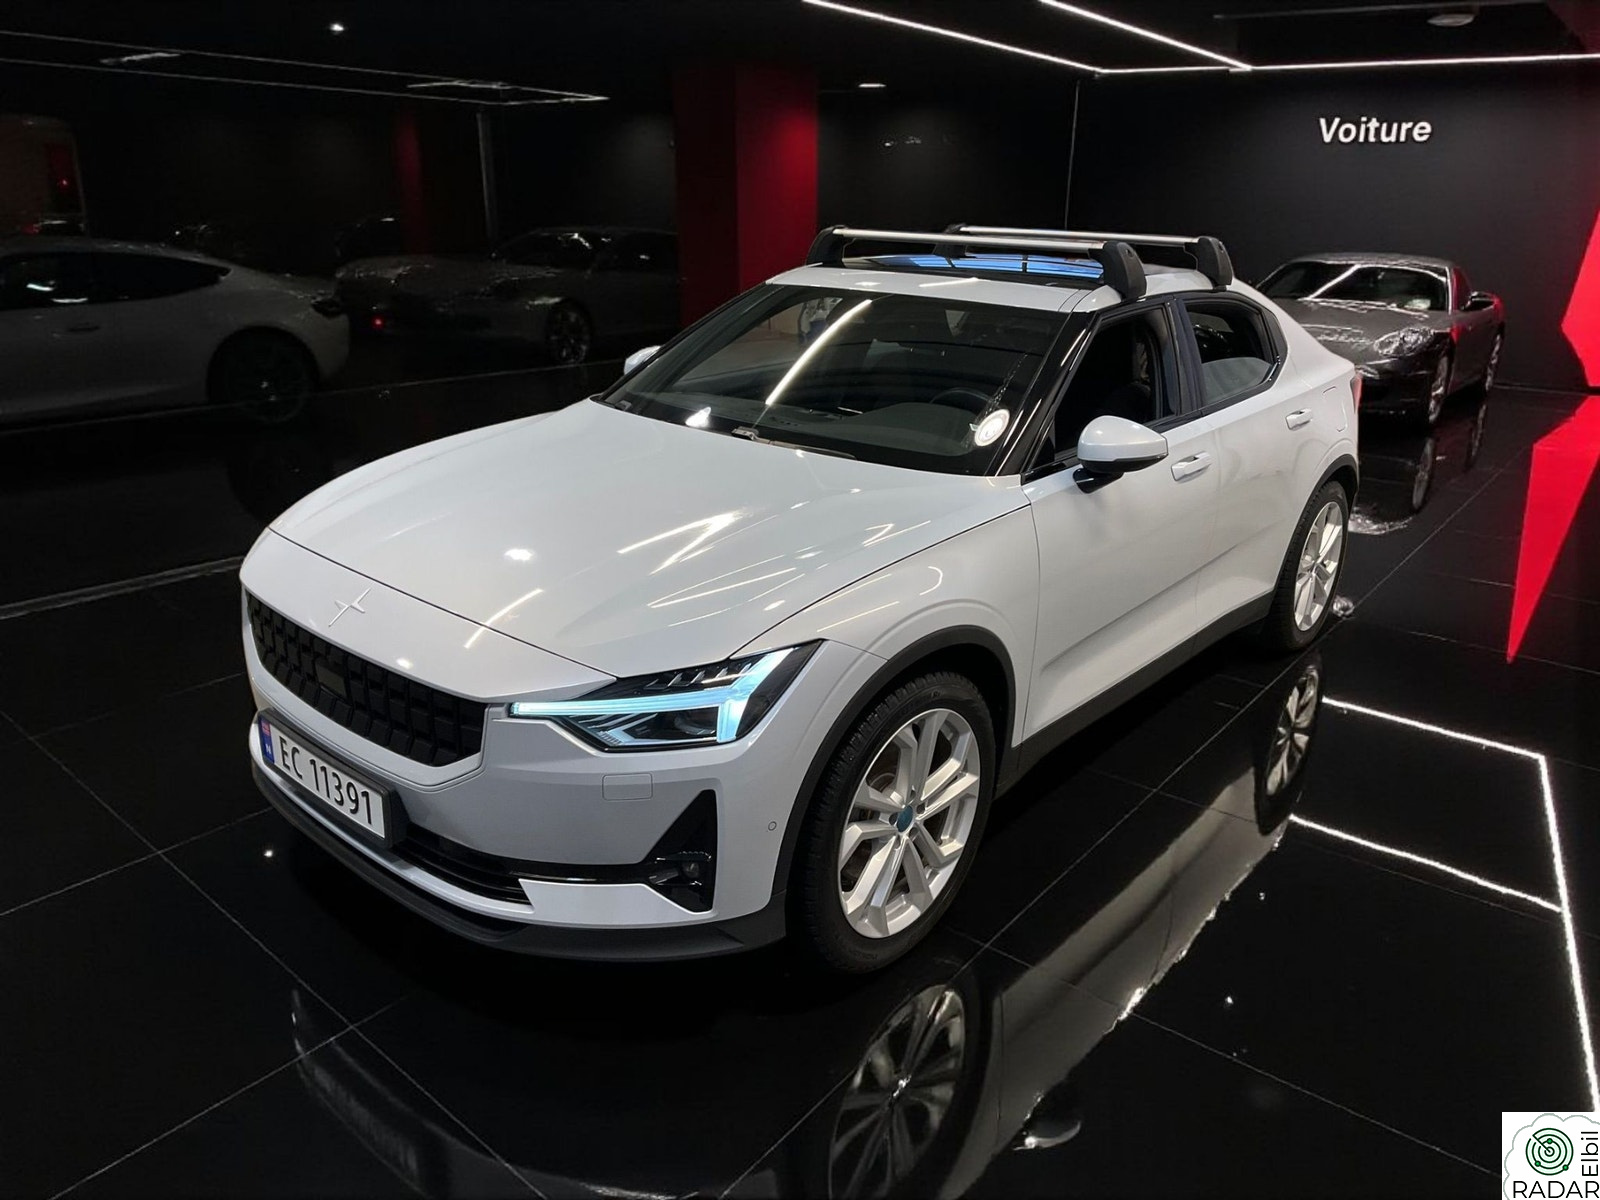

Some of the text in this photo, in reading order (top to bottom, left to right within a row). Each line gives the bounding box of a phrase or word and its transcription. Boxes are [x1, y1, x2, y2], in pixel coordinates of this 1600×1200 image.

[1319, 116, 1432, 143] Voiture
[279, 735, 372, 826] EC 11391
